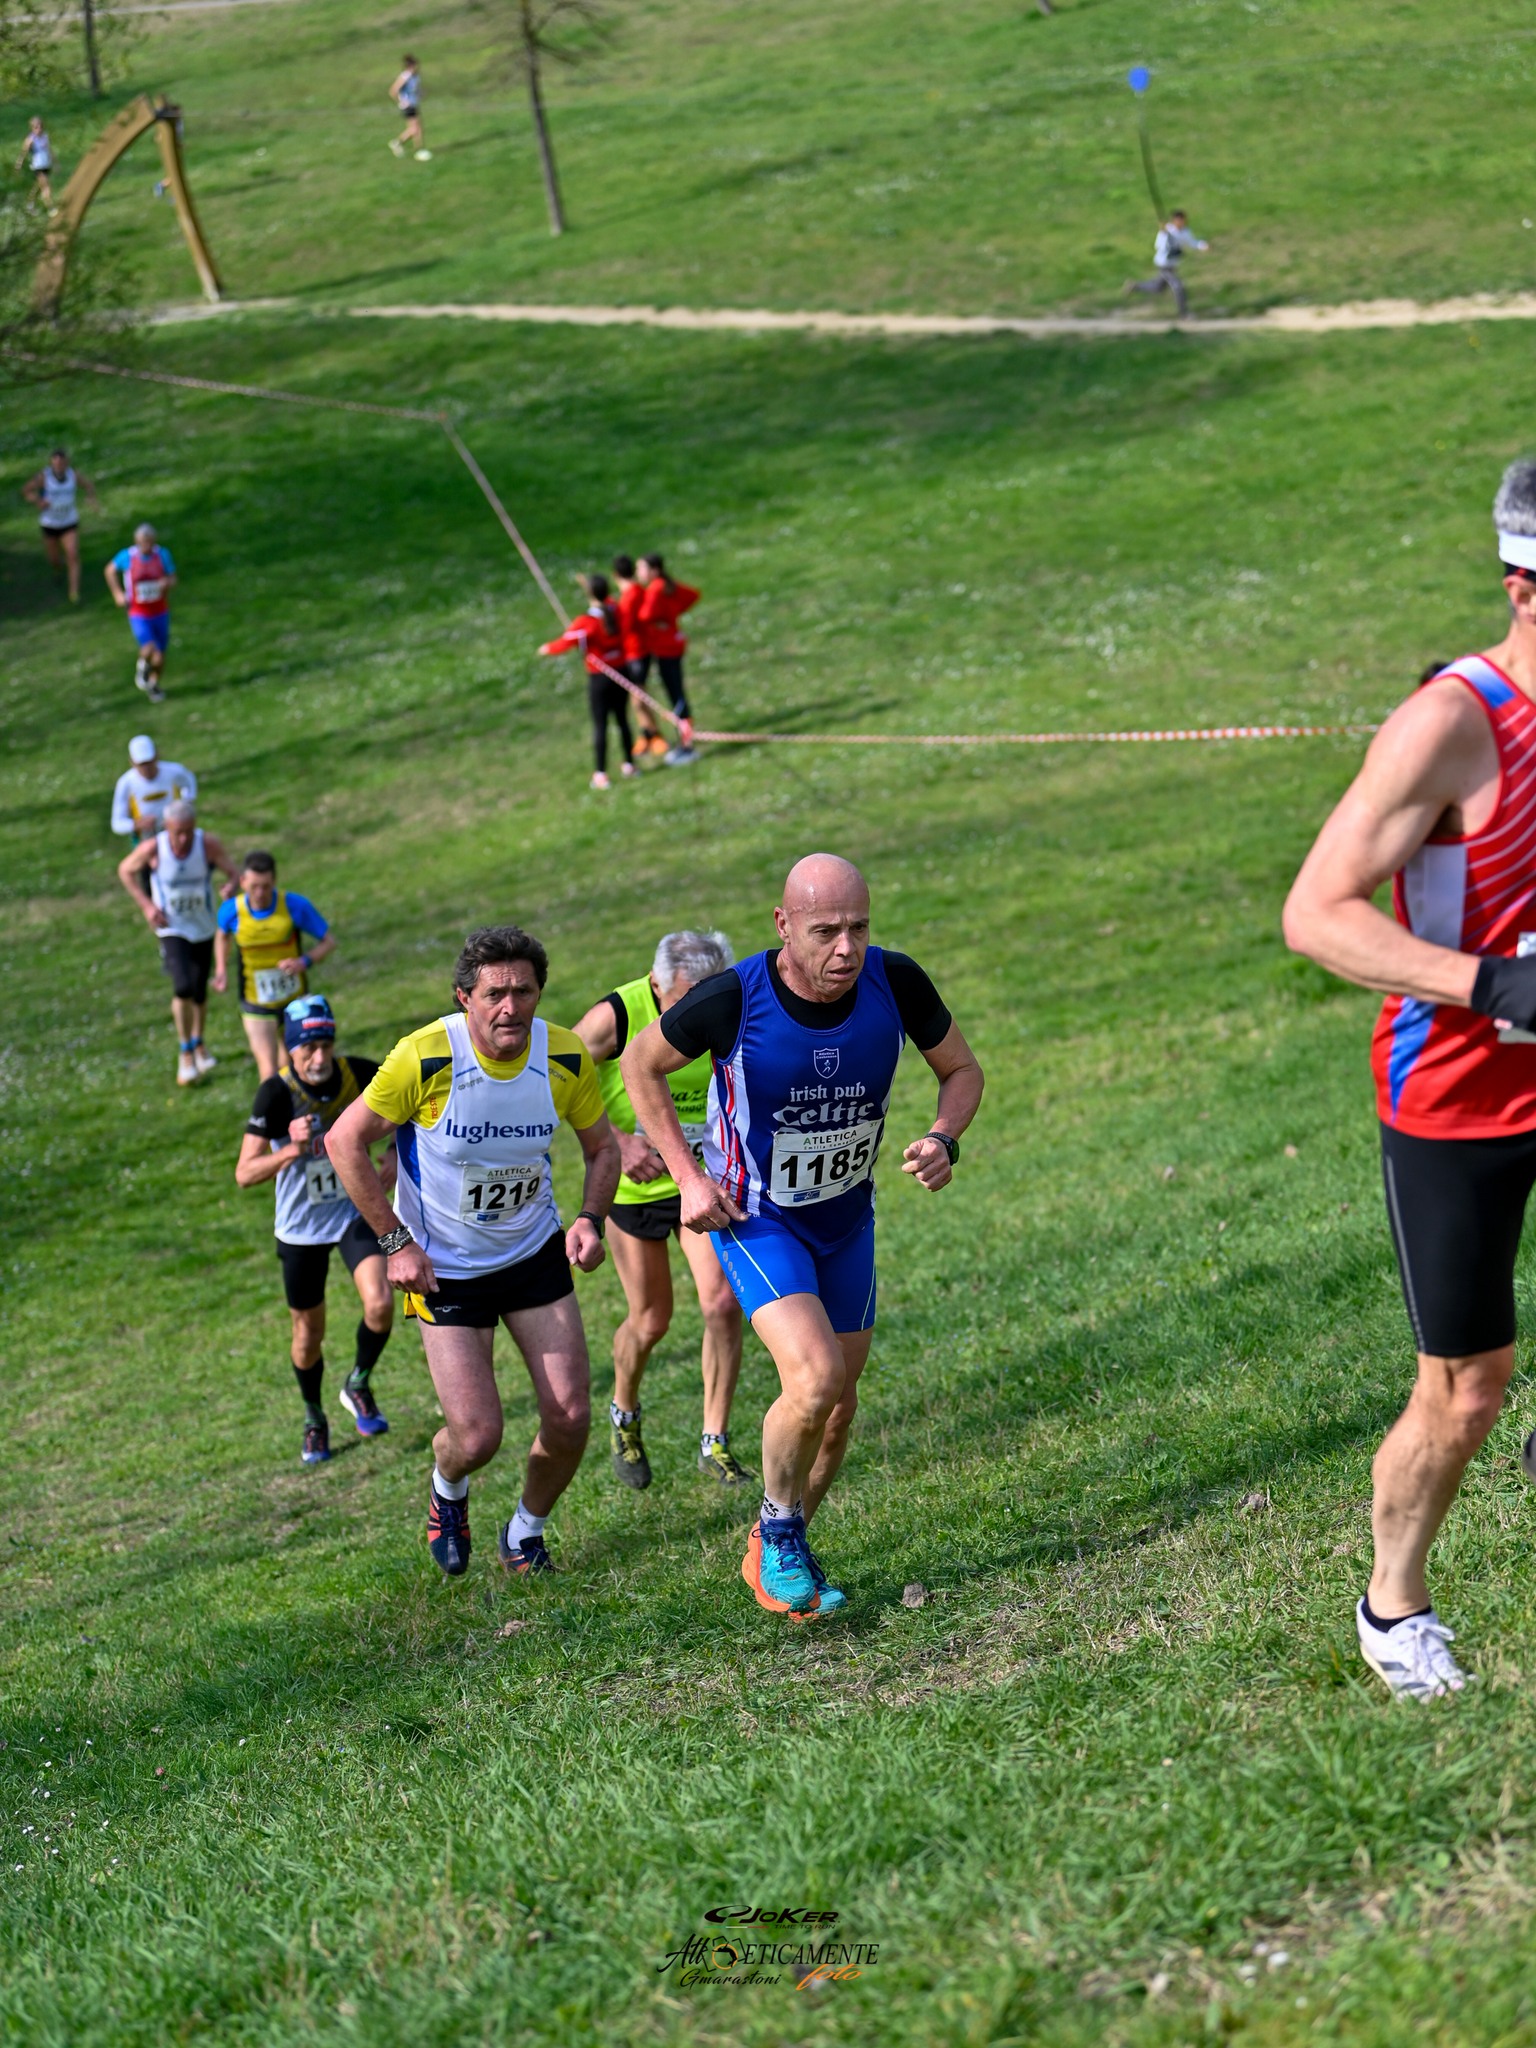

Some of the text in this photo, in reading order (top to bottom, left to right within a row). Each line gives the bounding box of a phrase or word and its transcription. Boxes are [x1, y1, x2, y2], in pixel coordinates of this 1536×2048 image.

[790, 1082, 866, 1102] irish pub
[773, 1101, 875, 1126] Celtic
[445, 1119, 553, 1144] lughesina
[803, 1129, 857, 1146] ATLETICA
[487, 1167, 532, 1177] ATLETICA
[780, 1137, 871, 1189] 1185
[312, 1172, 337, 1193] 11
[468, 1176, 540, 1210] 1219
